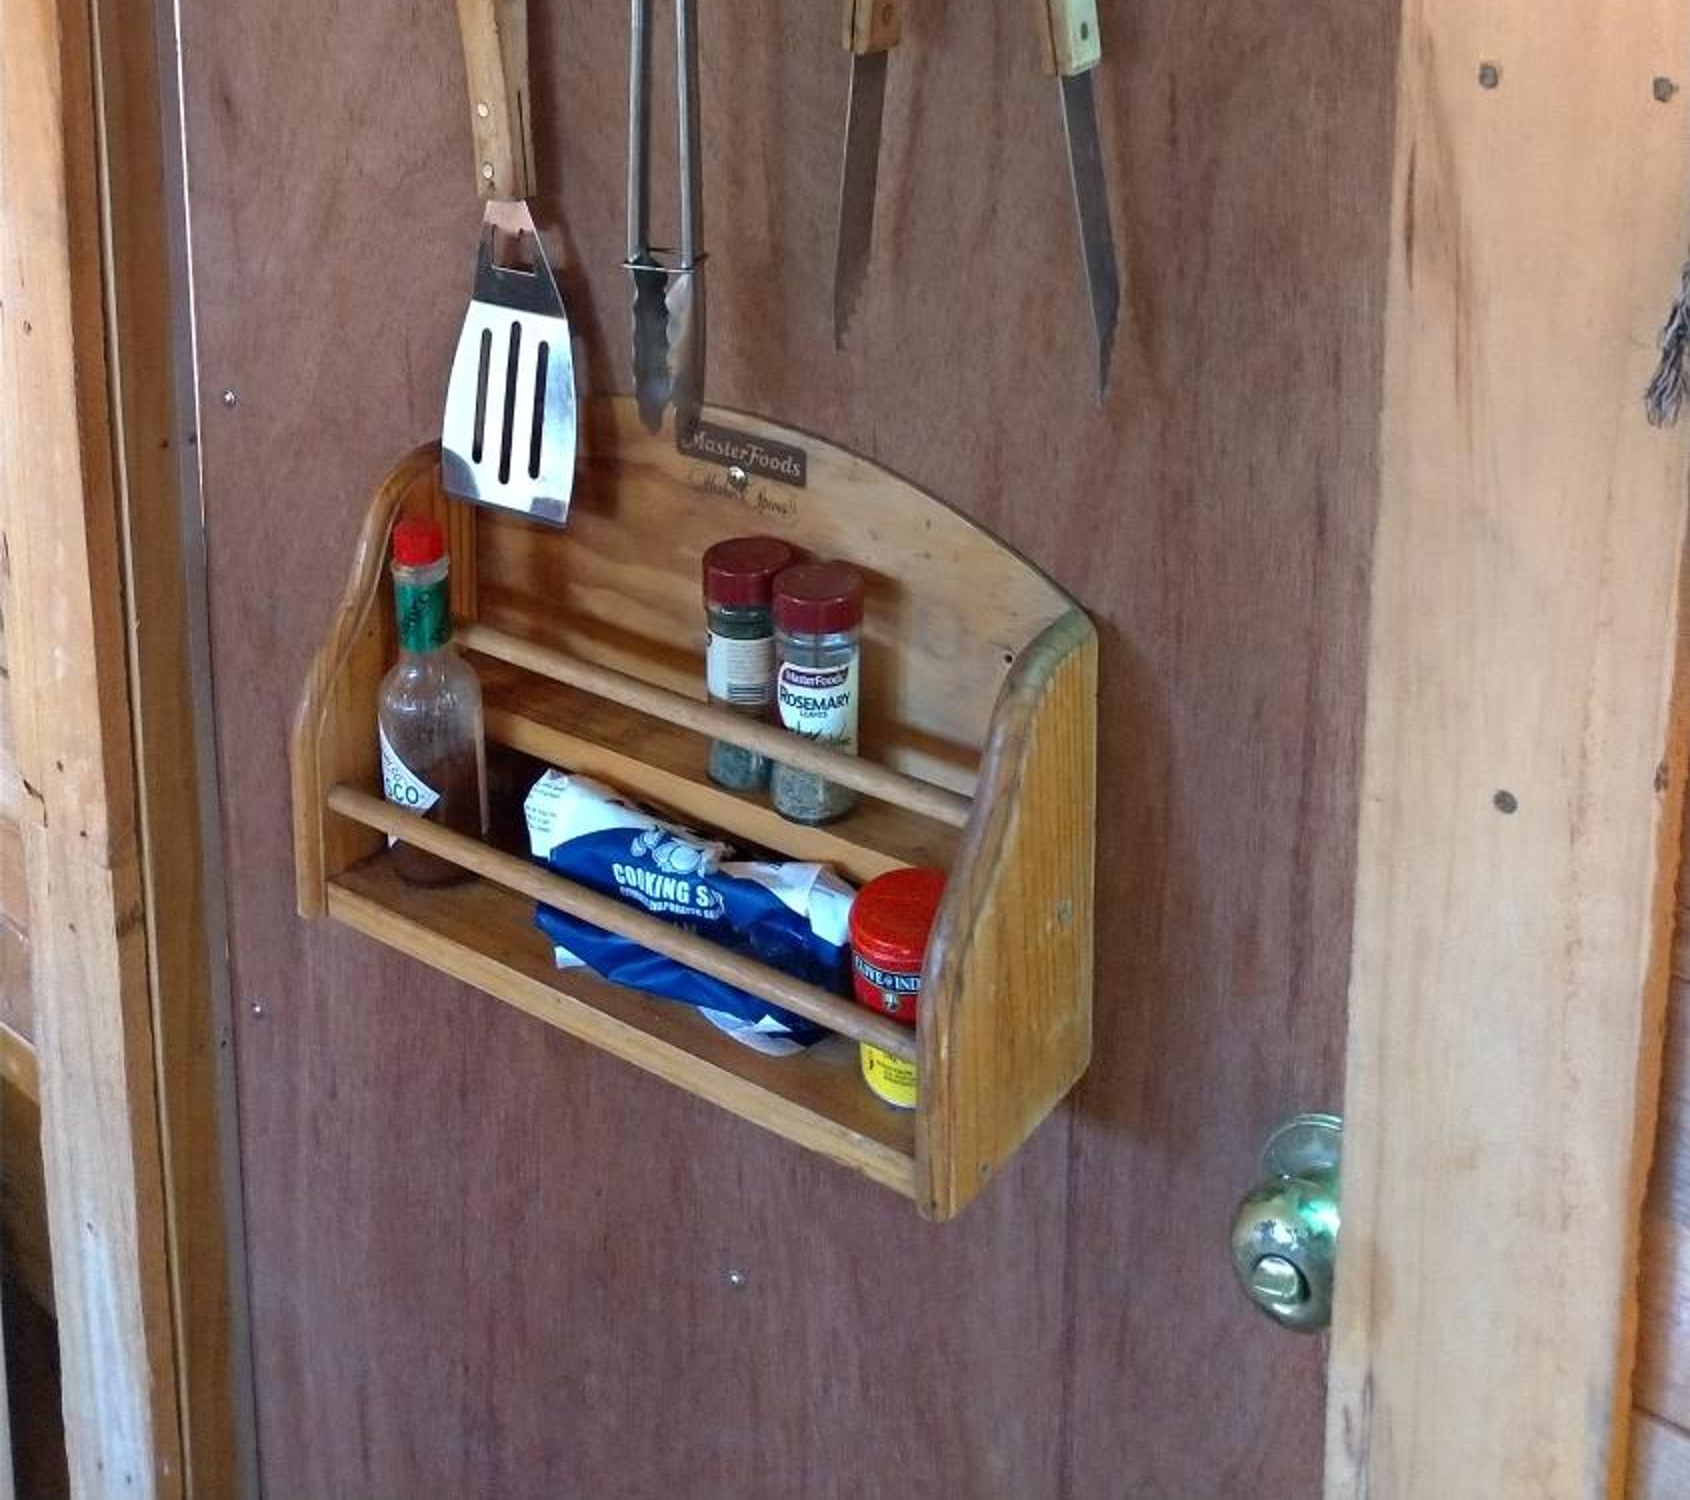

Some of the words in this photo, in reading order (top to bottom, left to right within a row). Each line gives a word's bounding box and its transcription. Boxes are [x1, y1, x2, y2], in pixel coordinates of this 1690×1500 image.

[681, 431, 802, 477] MasterFoods
[784, 669, 845, 687] MasterFoods
[780, 684, 851, 711] ROSEMARY
[612, 863, 690, 906] COOKING
[696, 885, 714, 908] S
[894, 975, 922, 991] IND
